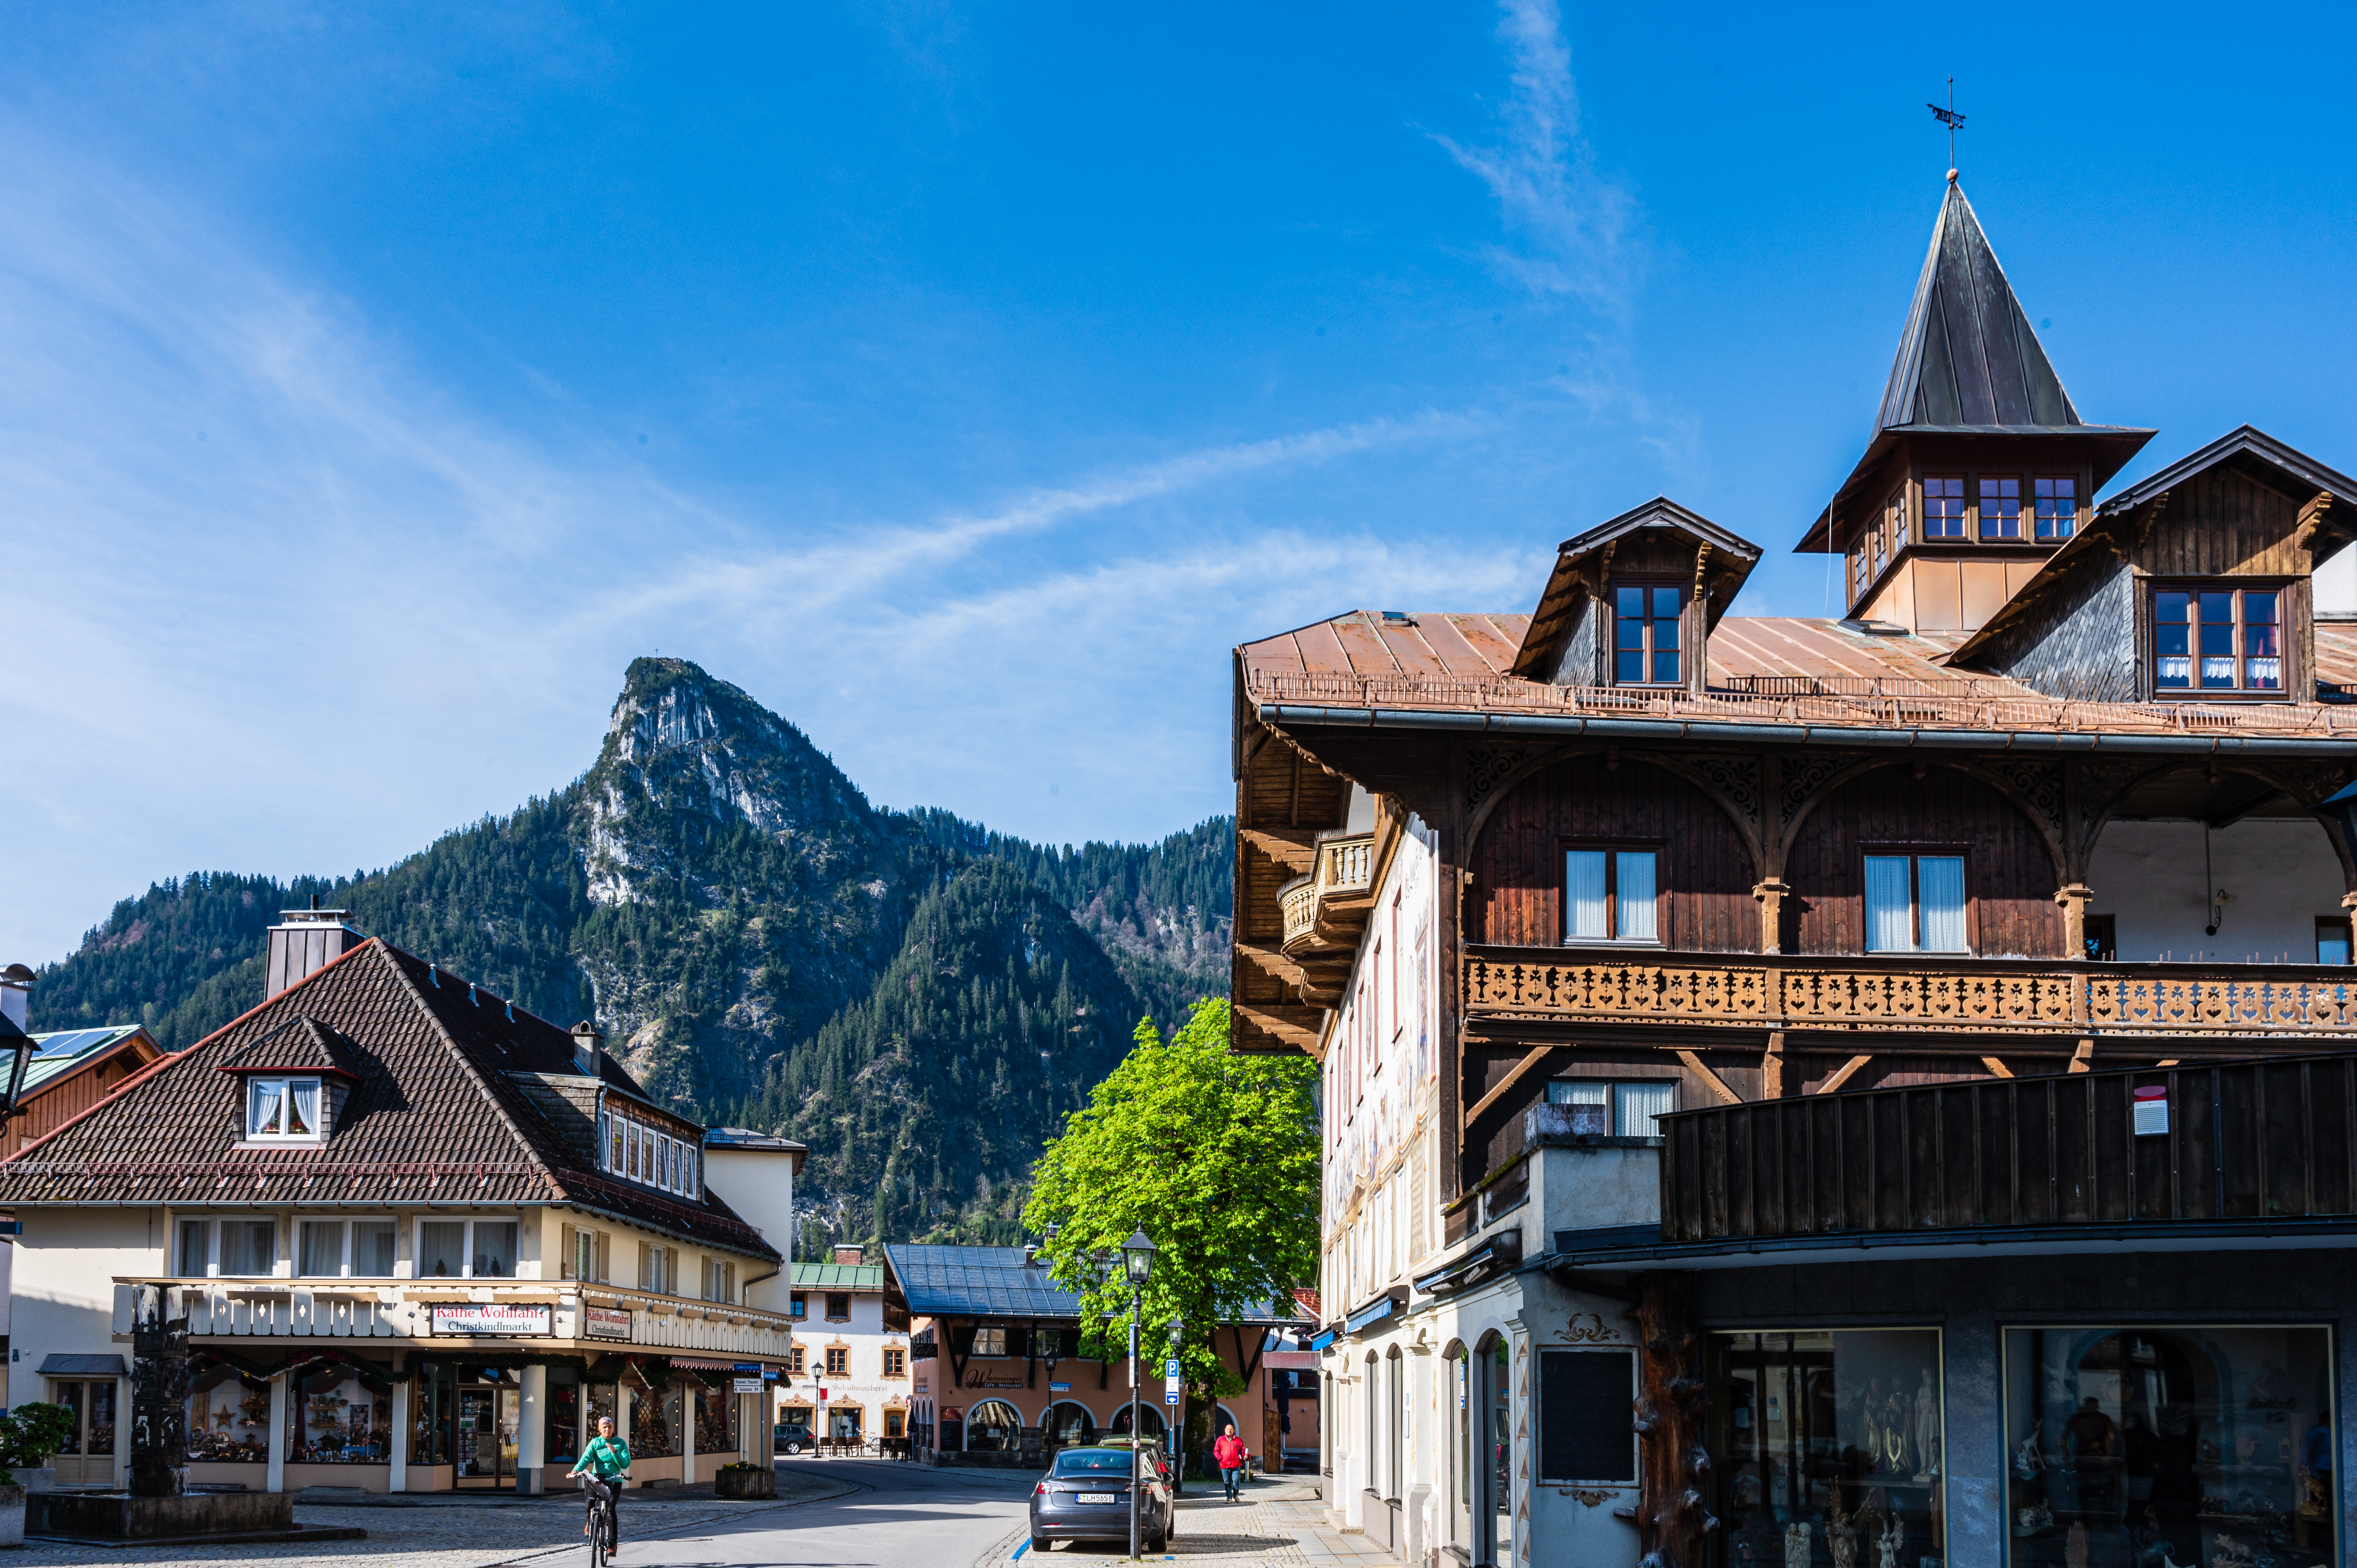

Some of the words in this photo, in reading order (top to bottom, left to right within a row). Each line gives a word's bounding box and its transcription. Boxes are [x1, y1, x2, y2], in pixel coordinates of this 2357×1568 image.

[436, 1306, 475, 1317] Käthe
[587, 1308, 603, 1321] Käthe
[448, 1321, 532, 1331] Christkindlmarkt
[592, 1324, 624, 1336] Christkindlmarkt
[966, 1368, 1023, 1390] Wanninger
[830, 1383, 887, 1391] Schuhmacherei
